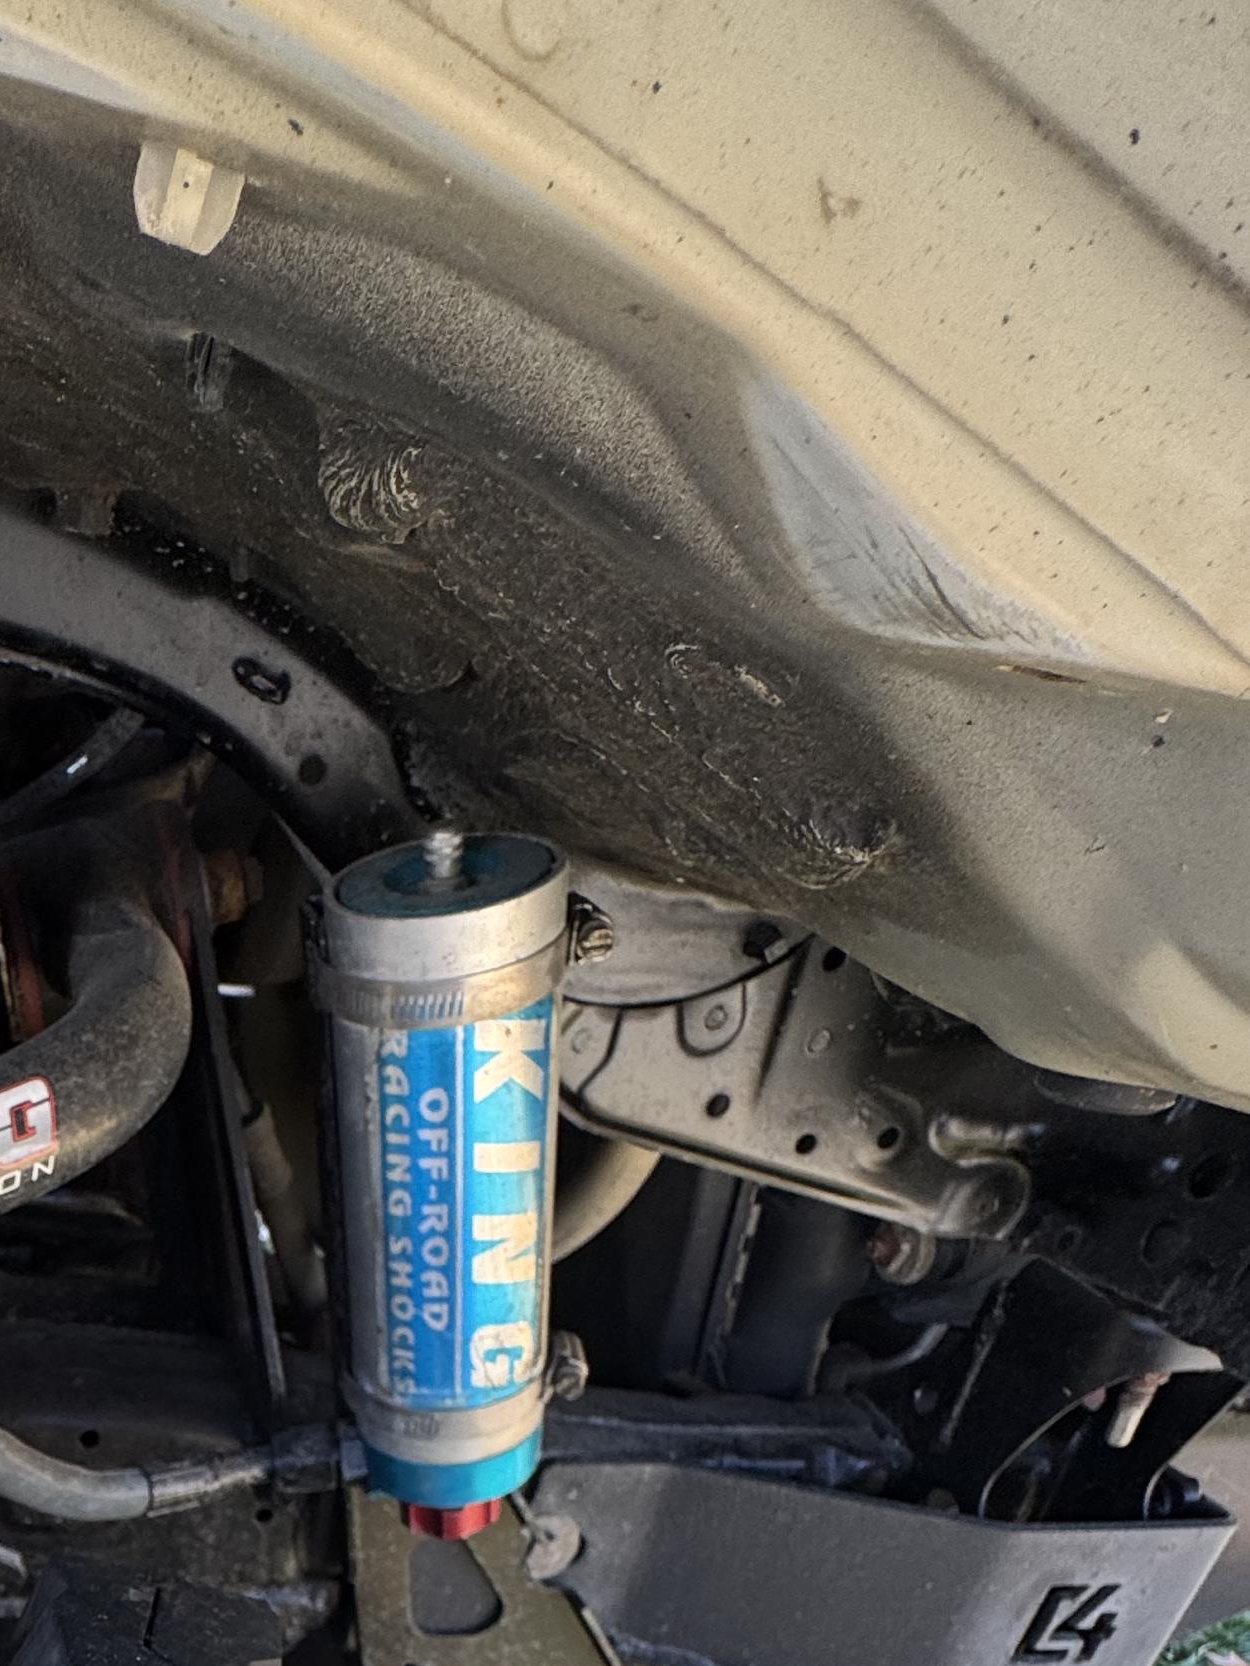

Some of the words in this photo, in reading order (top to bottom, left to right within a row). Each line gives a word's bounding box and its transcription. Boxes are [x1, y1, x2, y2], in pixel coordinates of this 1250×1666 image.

[381, 1028, 413, 1217] RACING
[416, 1087, 449, 1332] OFF-ROAD
[472, 1018, 547, 1389] KING
[387, 1235, 417, 1396] SHOCKS
